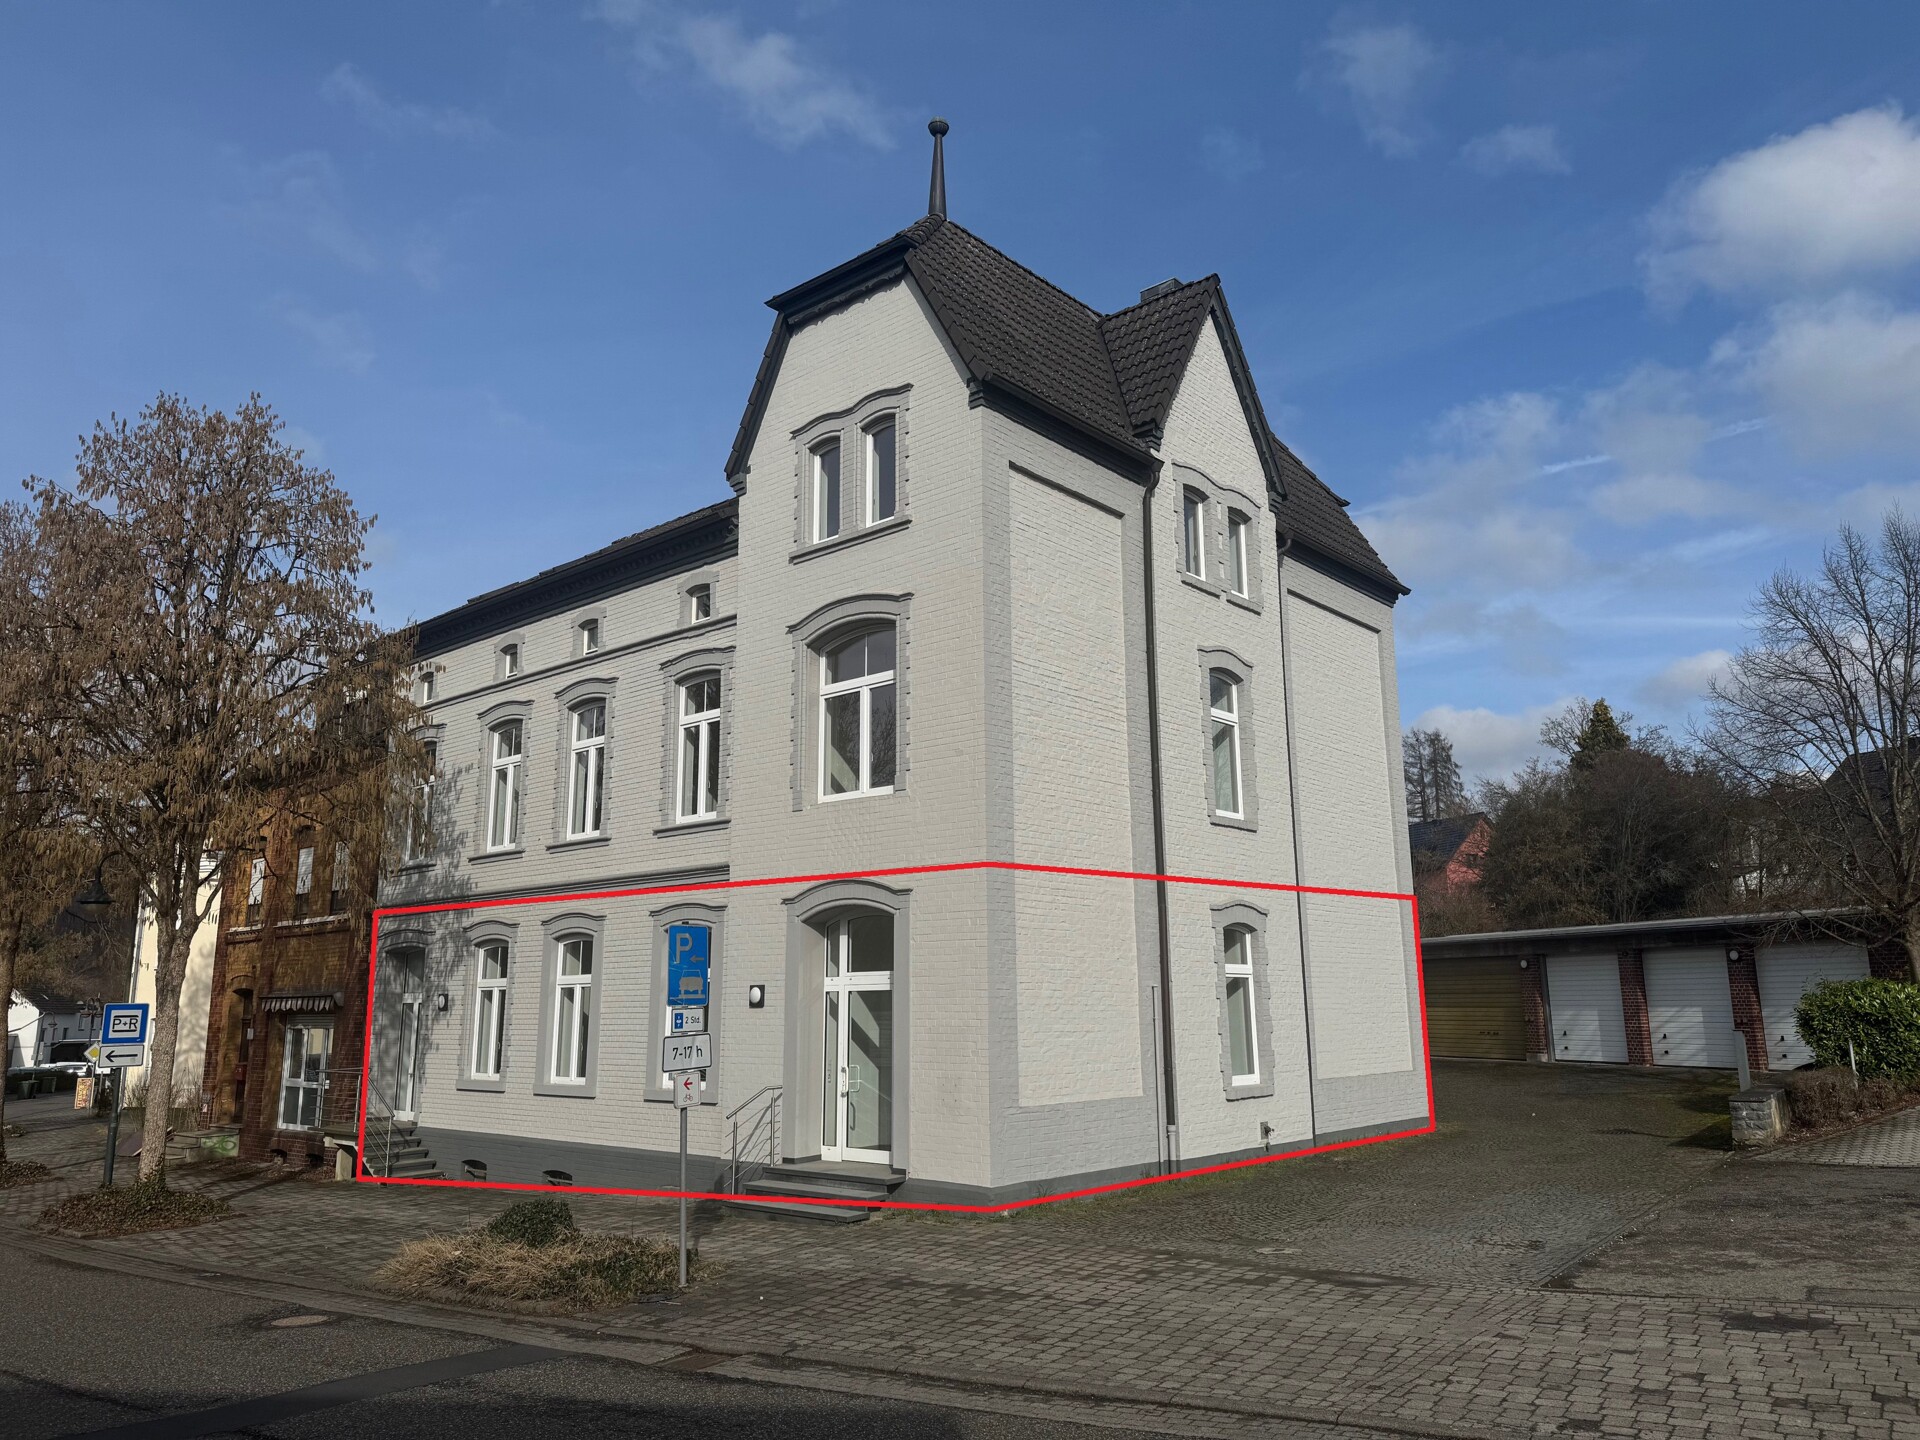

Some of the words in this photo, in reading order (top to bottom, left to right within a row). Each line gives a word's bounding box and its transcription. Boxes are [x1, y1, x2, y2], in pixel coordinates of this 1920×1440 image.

[676, 933, 692, 963] P
[112, 1018, 139, 1030] P+R
[685, 1016, 689, 1024] 2
[672, 1046, 693, 1060] 7-17
[695, 1045, 703, 1058] h
